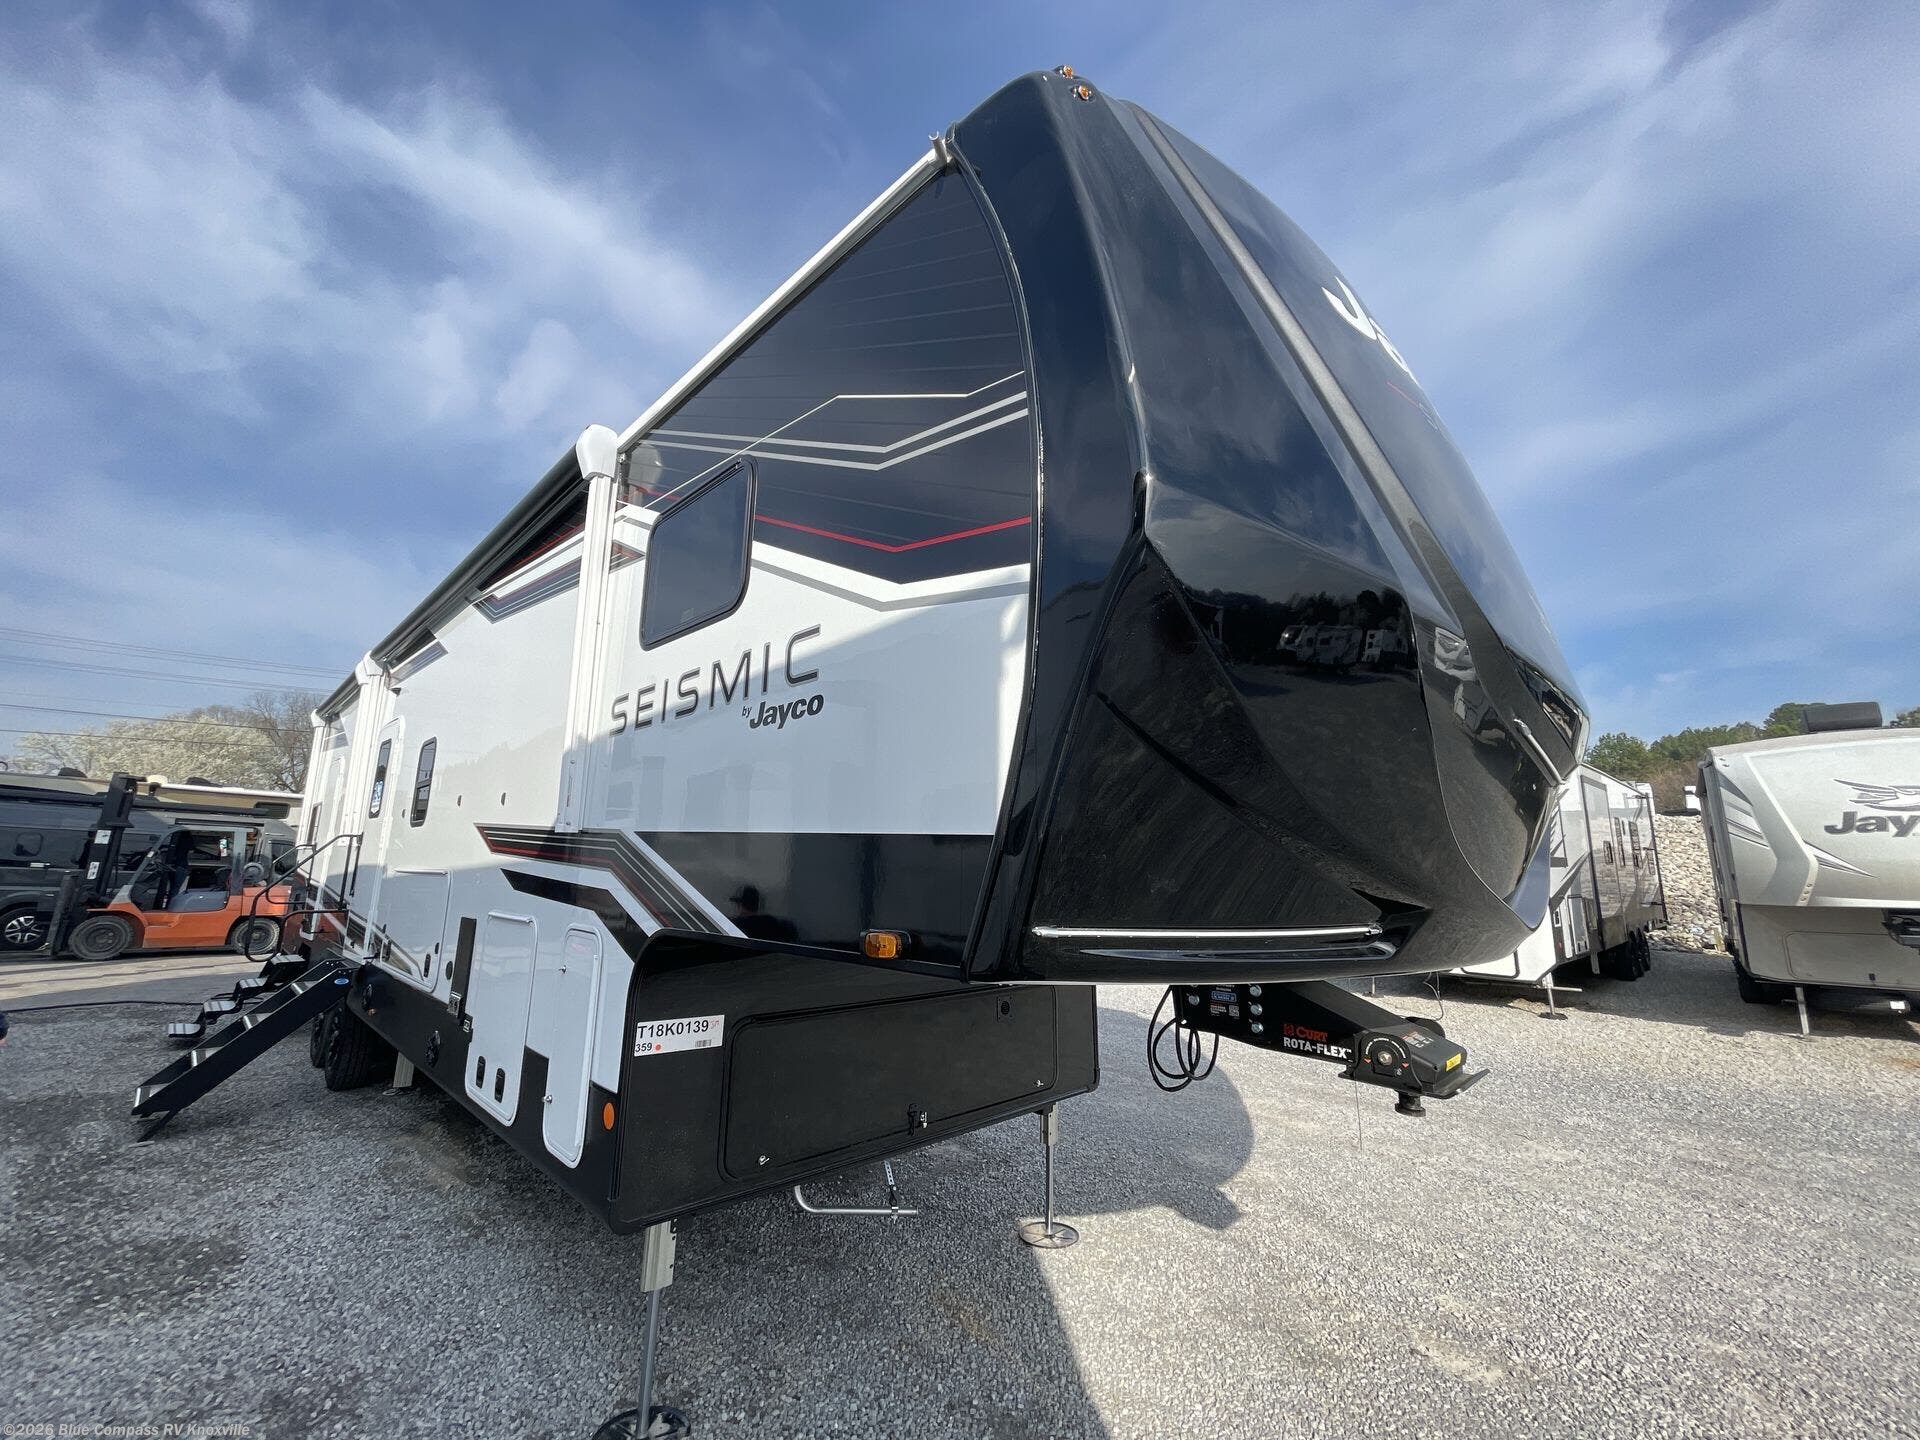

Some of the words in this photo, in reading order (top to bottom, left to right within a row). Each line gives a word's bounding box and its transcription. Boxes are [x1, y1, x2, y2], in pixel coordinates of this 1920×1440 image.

[608, 623, 822, 737] SEISMIC
[741, 705, 752, 719] by
[749, 693, 825, 730] Jayco
[637, 1019, 709, 1039] T18K0139
[1296, 1025, 1329, 1042] CURT
[634, 1042, 653, 1053] 359
